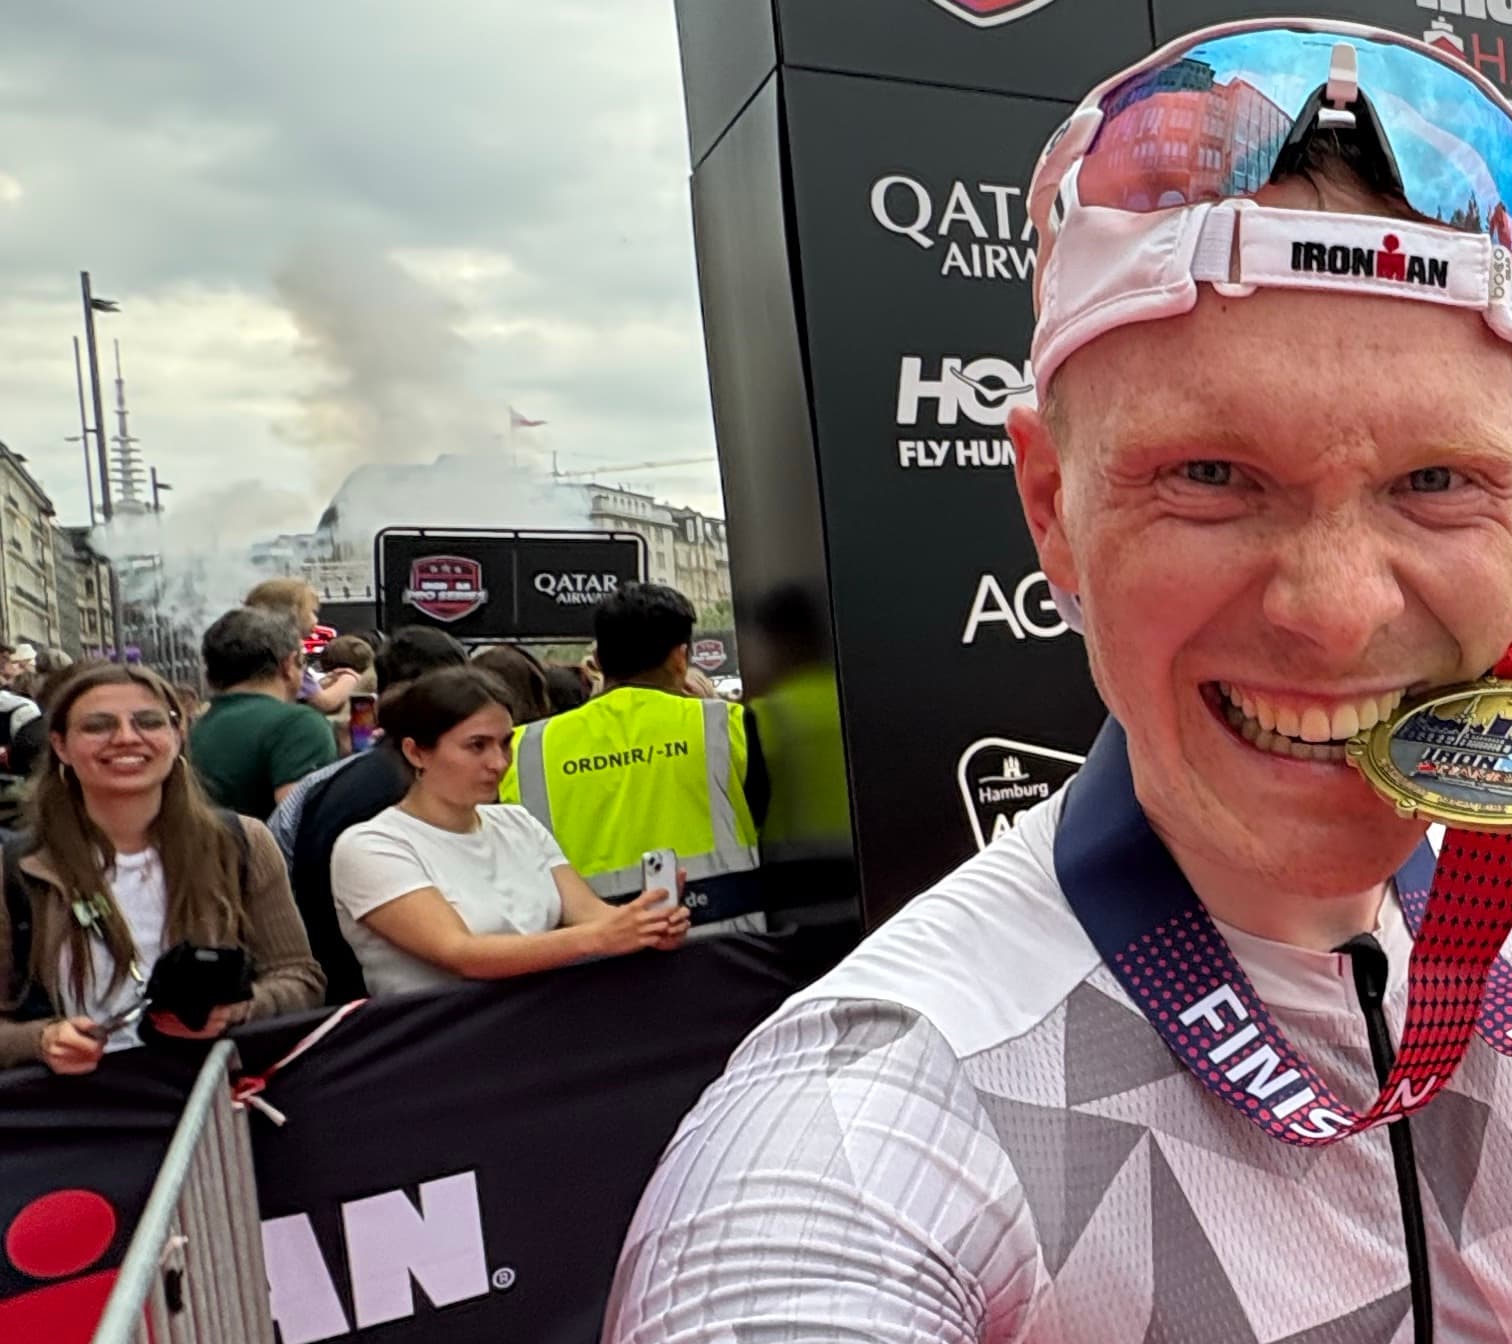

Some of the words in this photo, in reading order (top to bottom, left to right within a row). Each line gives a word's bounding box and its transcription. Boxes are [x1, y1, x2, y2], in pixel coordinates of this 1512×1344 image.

[870, 175, 1038, 248] QAT
[941, 242, 1038, 280] AIRW
[1291, 233, 1448, 289] IRONMAN
[897, 356, 1038, 425] HO
[898, 440, 950, 467] FLY
[534, 573, 618, 596] QATAR
[563, 741, 688, 775] ORDNER/-IN
[978, 782, 1049, 804] Hamburg
[1178, 983, 1354, 1139] FINIS
